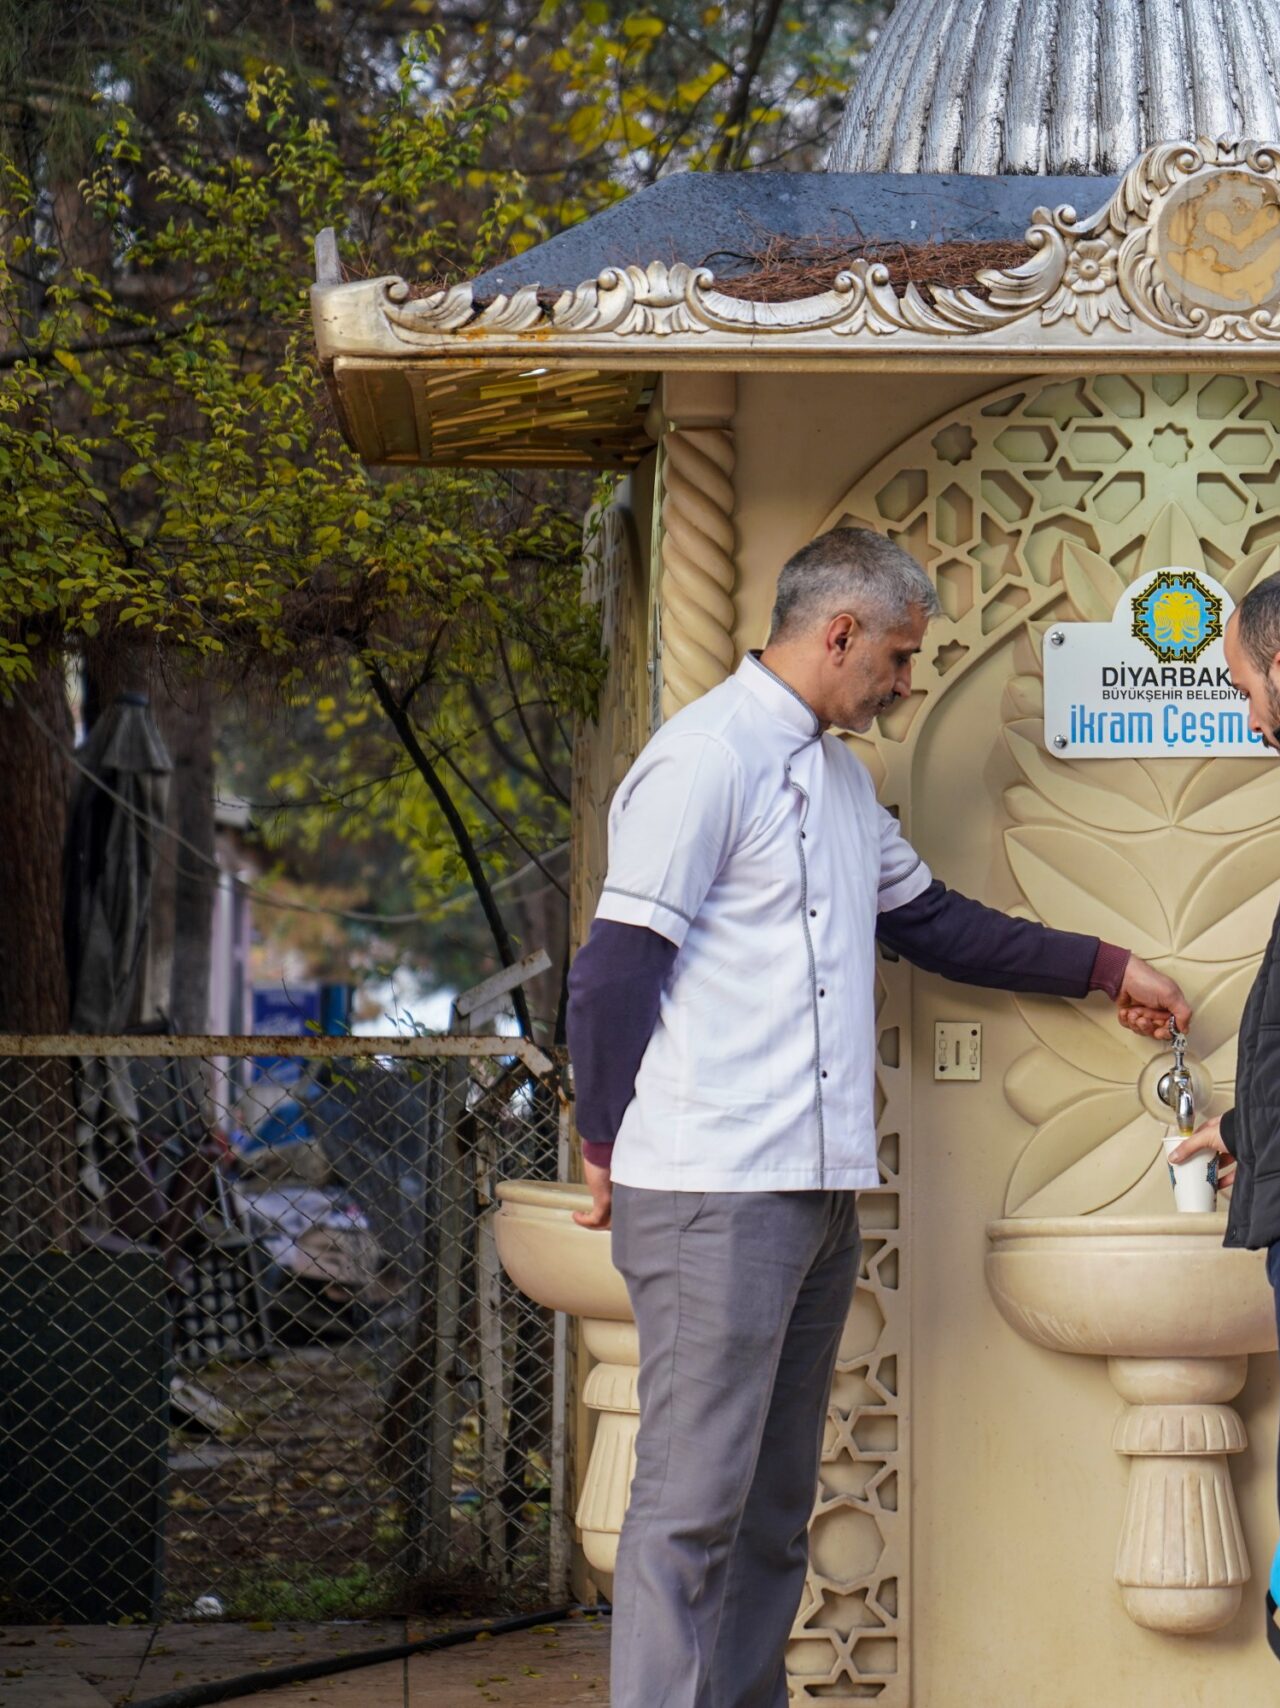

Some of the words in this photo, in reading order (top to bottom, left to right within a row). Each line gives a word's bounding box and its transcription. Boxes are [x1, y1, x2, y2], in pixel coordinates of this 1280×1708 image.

[1102, 661, 1233, 687] DİYARBAK
[1102, 687, 1183, 702] BÜYÜKŞEHİR
[1186, 687, 1248, 700] BELEDİYE
